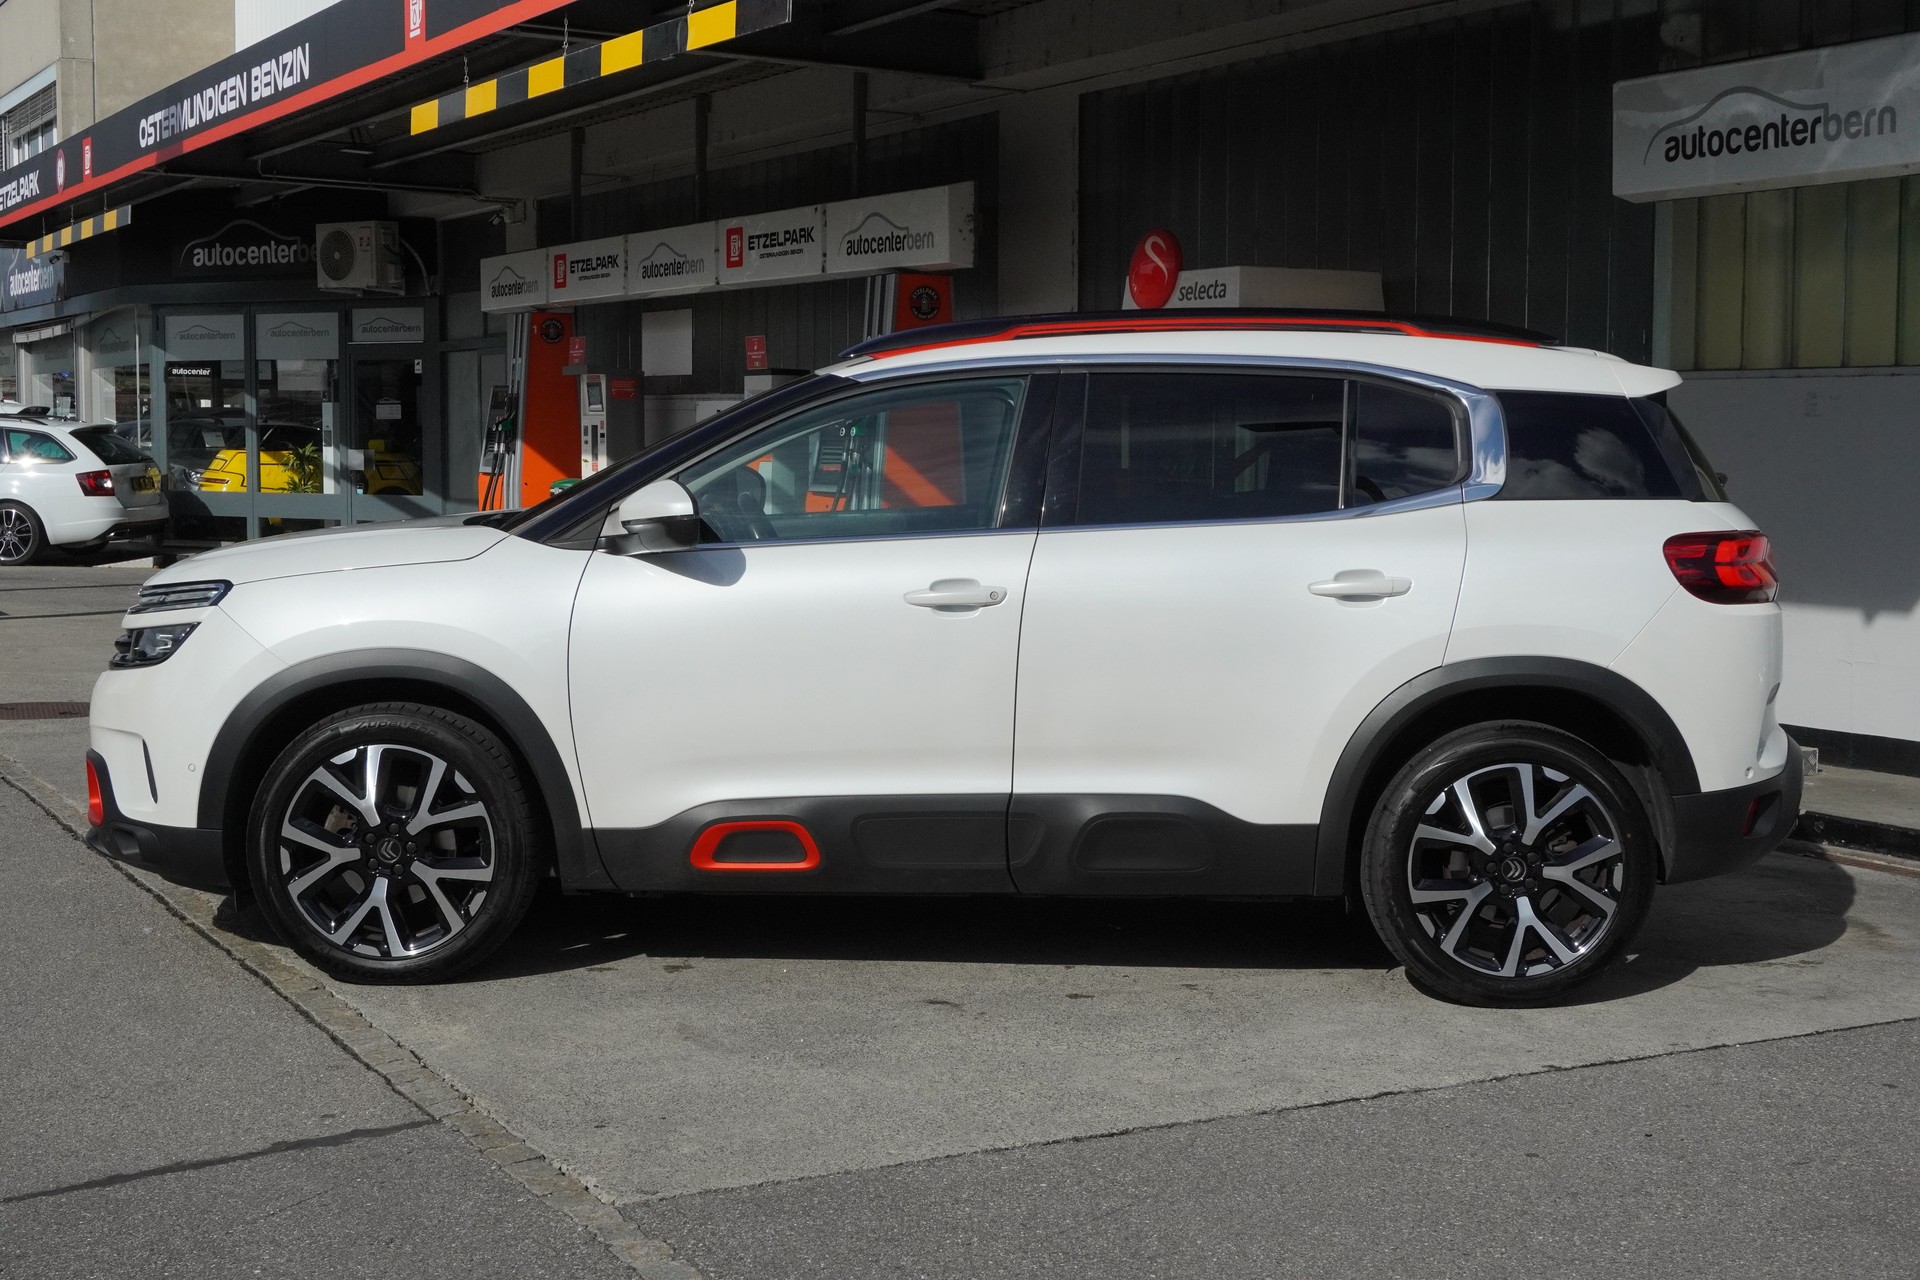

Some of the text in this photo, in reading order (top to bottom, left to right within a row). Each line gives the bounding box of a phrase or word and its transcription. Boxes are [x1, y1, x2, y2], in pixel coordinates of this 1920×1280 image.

[139, 42, 310, 148] OSTERMUNDIGEN BENZIN
[1664, 104, 1897, 162] autocenterbern
[748, 226, 815, 251] ETZELPARK
[846, 229, 934, 257] autocenterbern
[570, 254, 619, 274] ETZELPARK
[641, 257, 705, 280] autocenterbern
[9, 263, 54, 297] autocenterbern
[491, 279, 539, 298] autocenterbern
[1178, 279, 1227, 301] selecta
[179, 331, 236, 341] autocenterbern
[270, 328, 330, 338] autocenterbern
[361, 323, 421, 334] autocenterbern
[172, 367, 211, 376] autocenter
